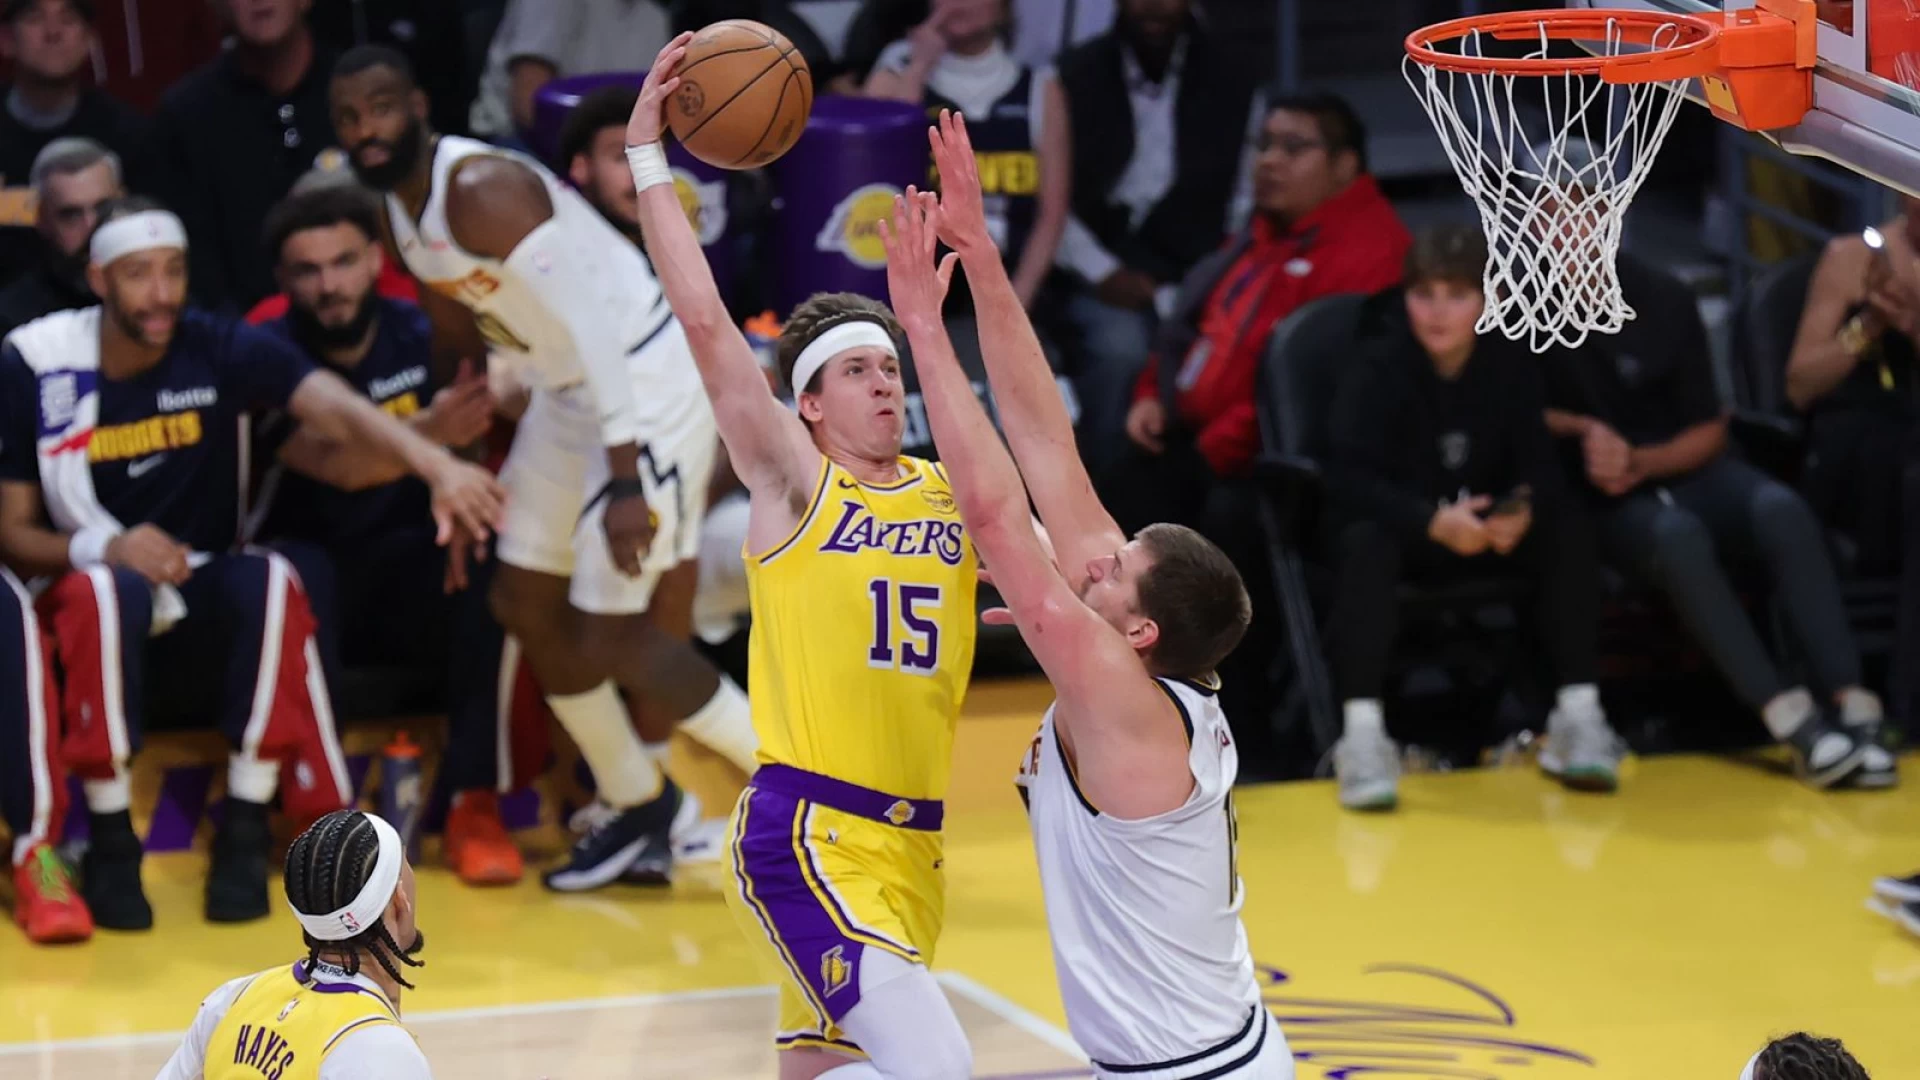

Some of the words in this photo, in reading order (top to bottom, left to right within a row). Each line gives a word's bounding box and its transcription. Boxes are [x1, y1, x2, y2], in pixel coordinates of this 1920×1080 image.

[819, 500, 964, 566] LAKERS
[867, 577, 942, 677] 15
[234, 1024, 295, 1080] HAYES
